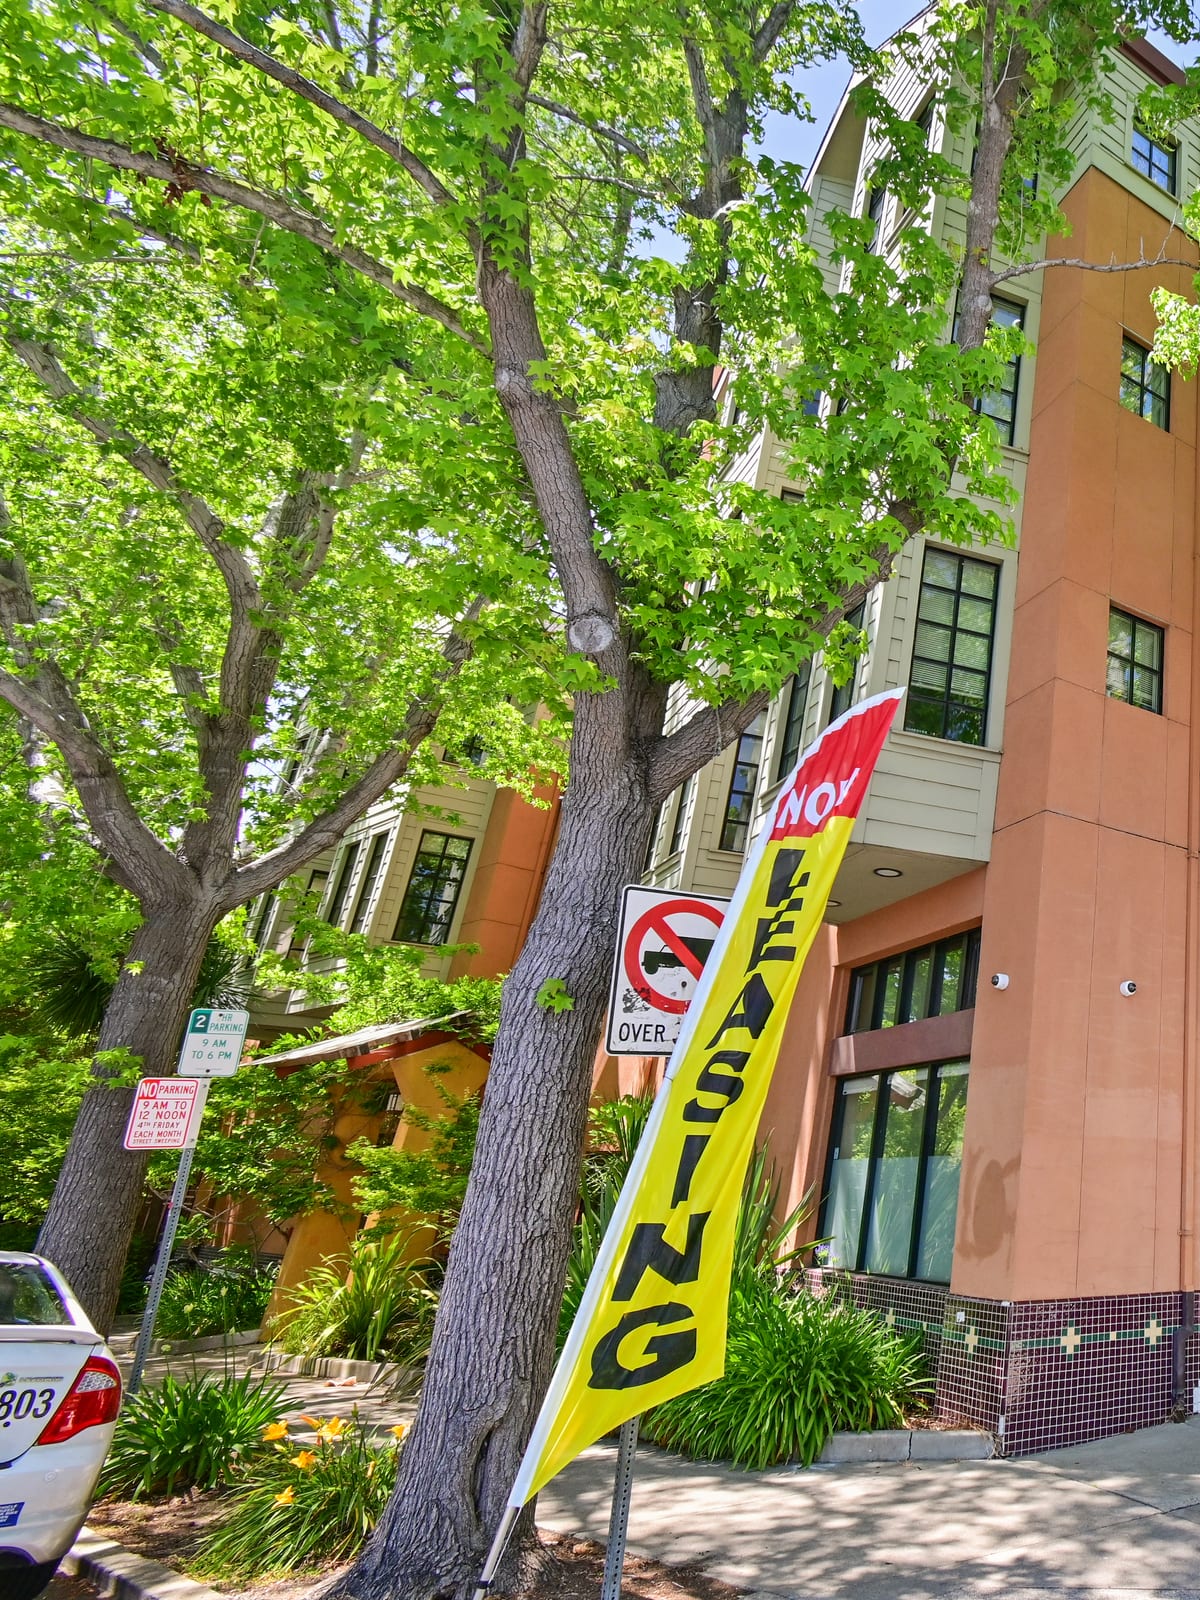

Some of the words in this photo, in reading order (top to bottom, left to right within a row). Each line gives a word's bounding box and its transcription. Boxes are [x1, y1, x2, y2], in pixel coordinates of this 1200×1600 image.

[194, 1015, 207, 1028] 2
[221, 1013, 233, 1022] HR
[209, 1022, 244, 1033] PARKING
[618, 1022, 666, 1043] OVER
[202, 1038, 209, 1047] 9
[212, 1039, 227, 1047] AM
[191, 1050, 204, 1059] TO
[207, 1051, 214, 1060] 6
[218, 1051, 233, 1060] PM
[140, 1082, 158, 1098] NO
[159, 1084, 195, 1095] PARKING
[143, 1101, 149, 1109] 9
[152, 1101, 168, 1109] AM
[174, 1101, 187, 1109] TO
[138, 1111, 150, 1120] 12
[156, 1111, 187, 1120] NOON
[587, 848, 811, 1390] LEASING
[137, 1121, 150, 1129] 4TH
[153, 1121, 180, 1129] FRIDAY
[157, 1130, 182, 1138] MONTH
[0, 1388, 56, 1421] 803
